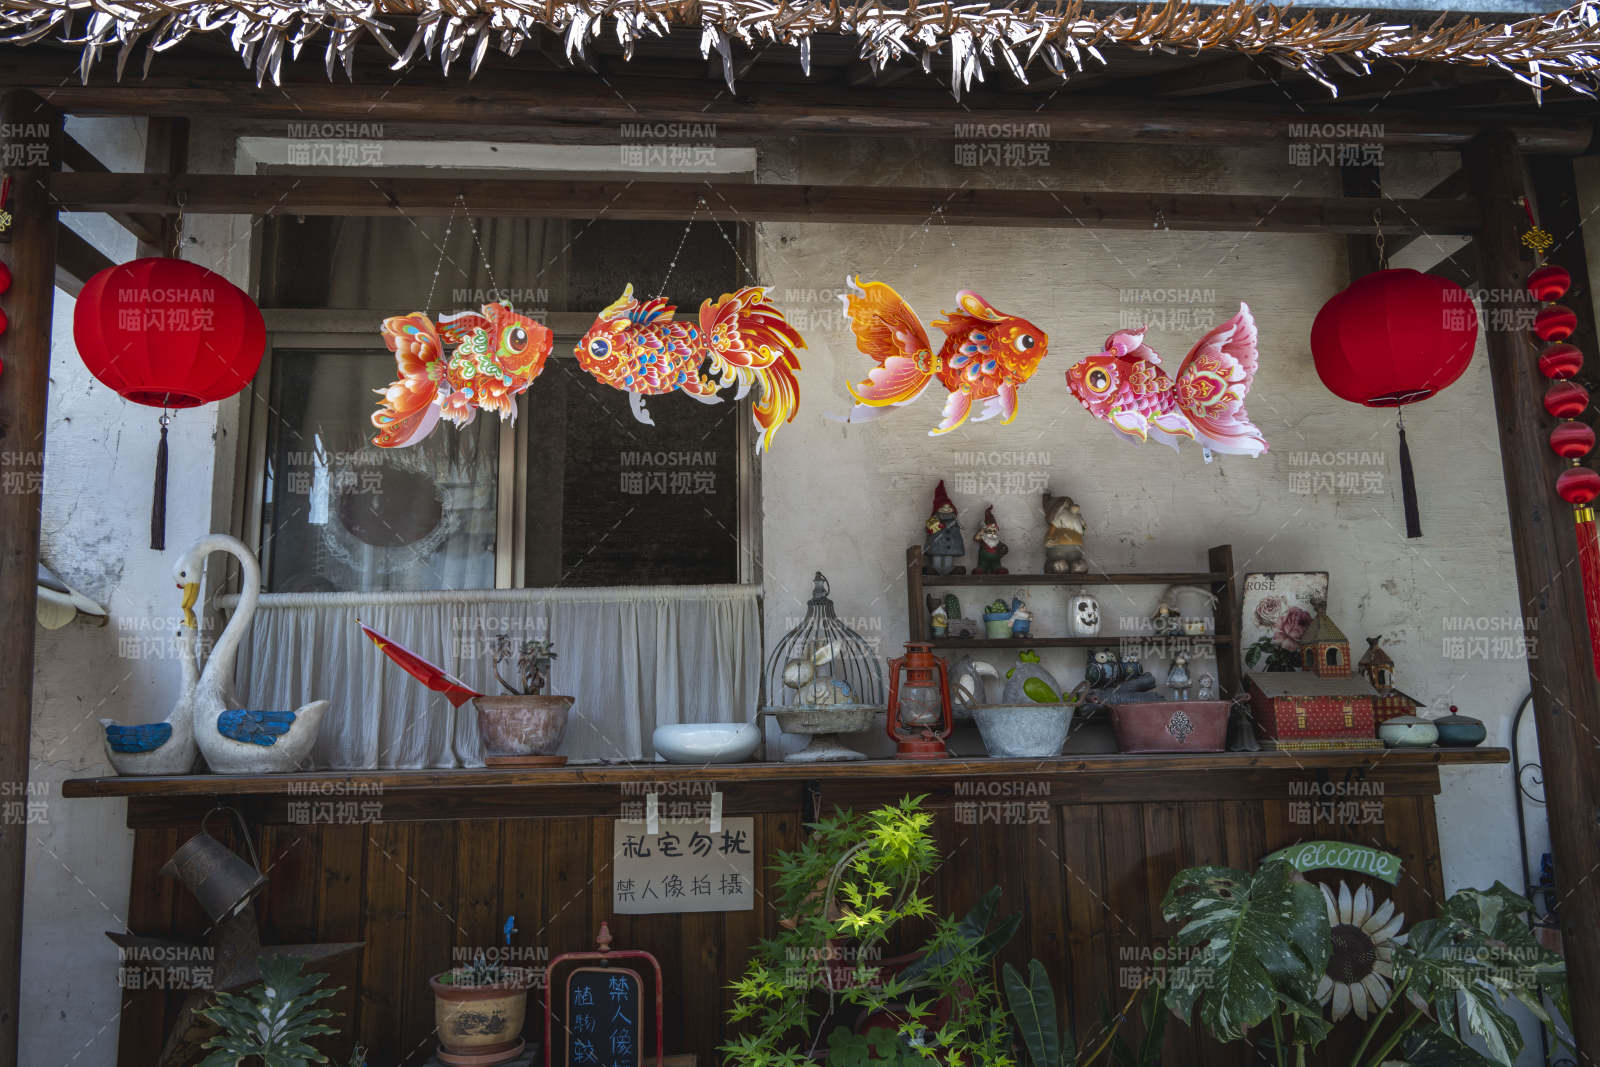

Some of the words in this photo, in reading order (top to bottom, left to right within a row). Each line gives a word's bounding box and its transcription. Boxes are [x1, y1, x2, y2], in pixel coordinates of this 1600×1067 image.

[1245, 581, 1276, 591] ROSE
[622, 831, 751, 858] 私宅勿扰
[616, 873, 743, 902] 禁人像拍摄
[608, 975, 632, 1067] 禁人像
